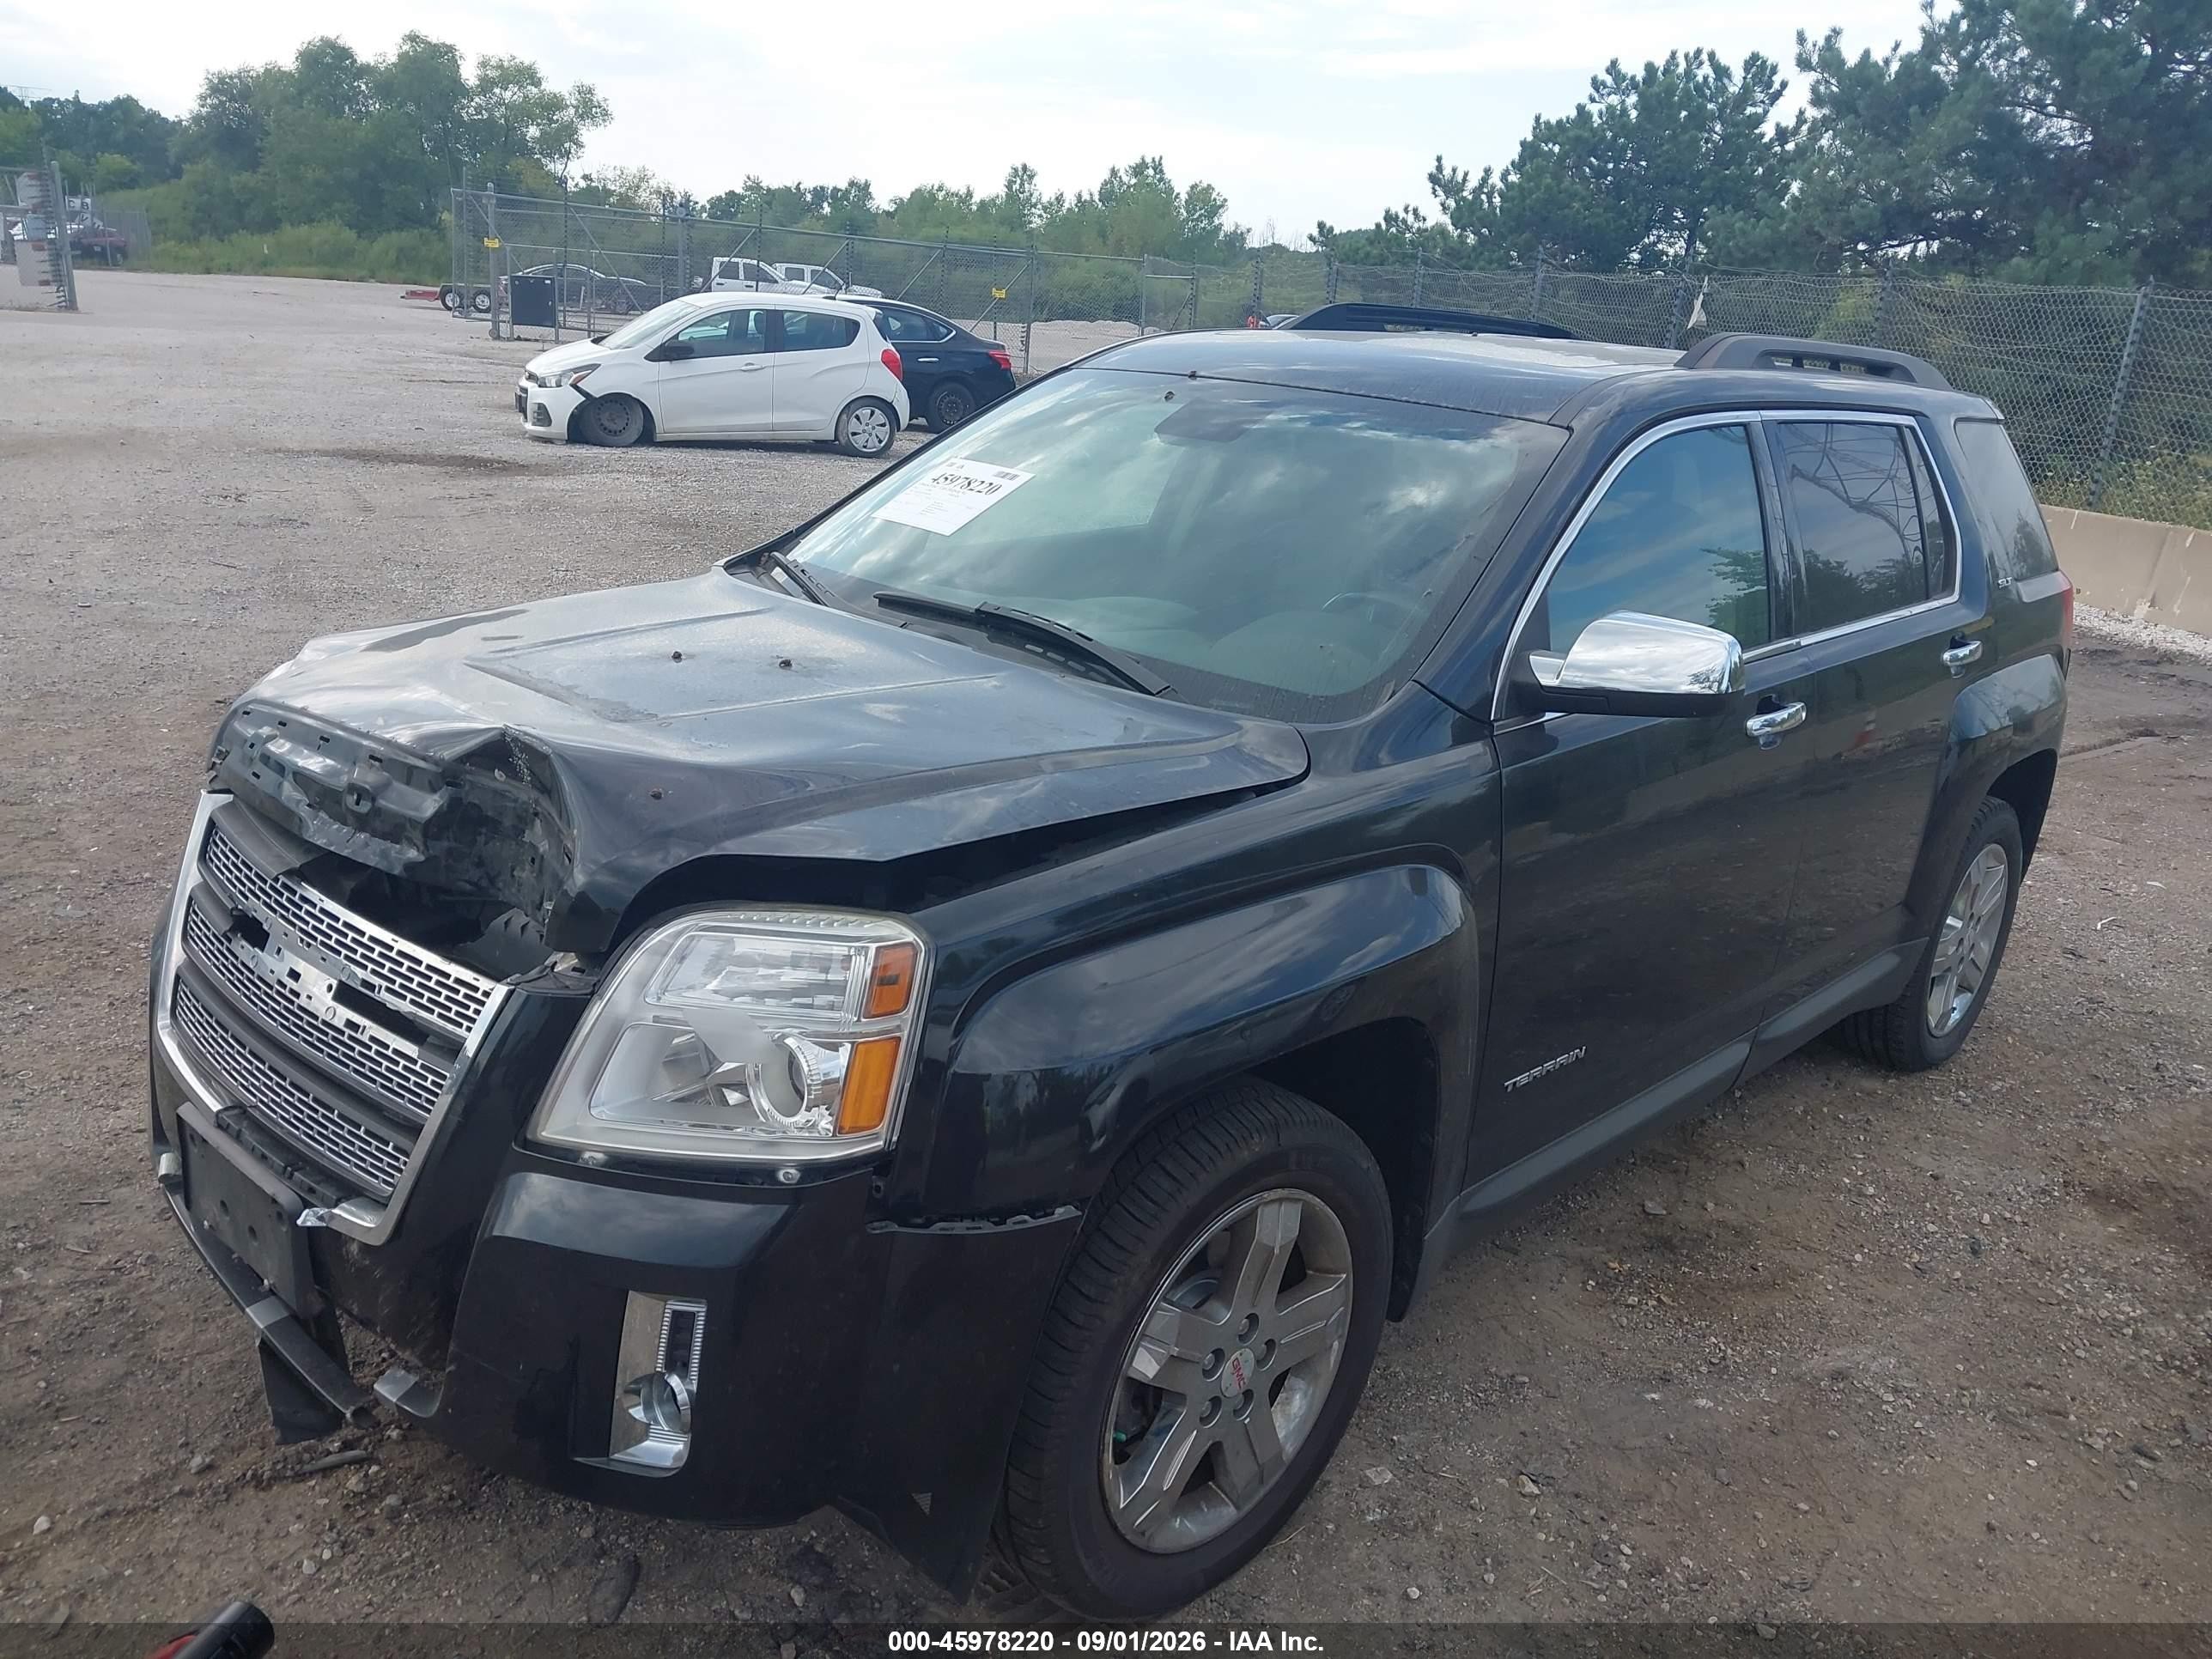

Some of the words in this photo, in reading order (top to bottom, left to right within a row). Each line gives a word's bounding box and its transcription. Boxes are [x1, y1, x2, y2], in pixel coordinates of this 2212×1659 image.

[932, 472, 1003, 495] 45978220
[1503, 1045, 1587, 1093] TERRAIN
[1231, 1357, 1247, 1391] GMC
